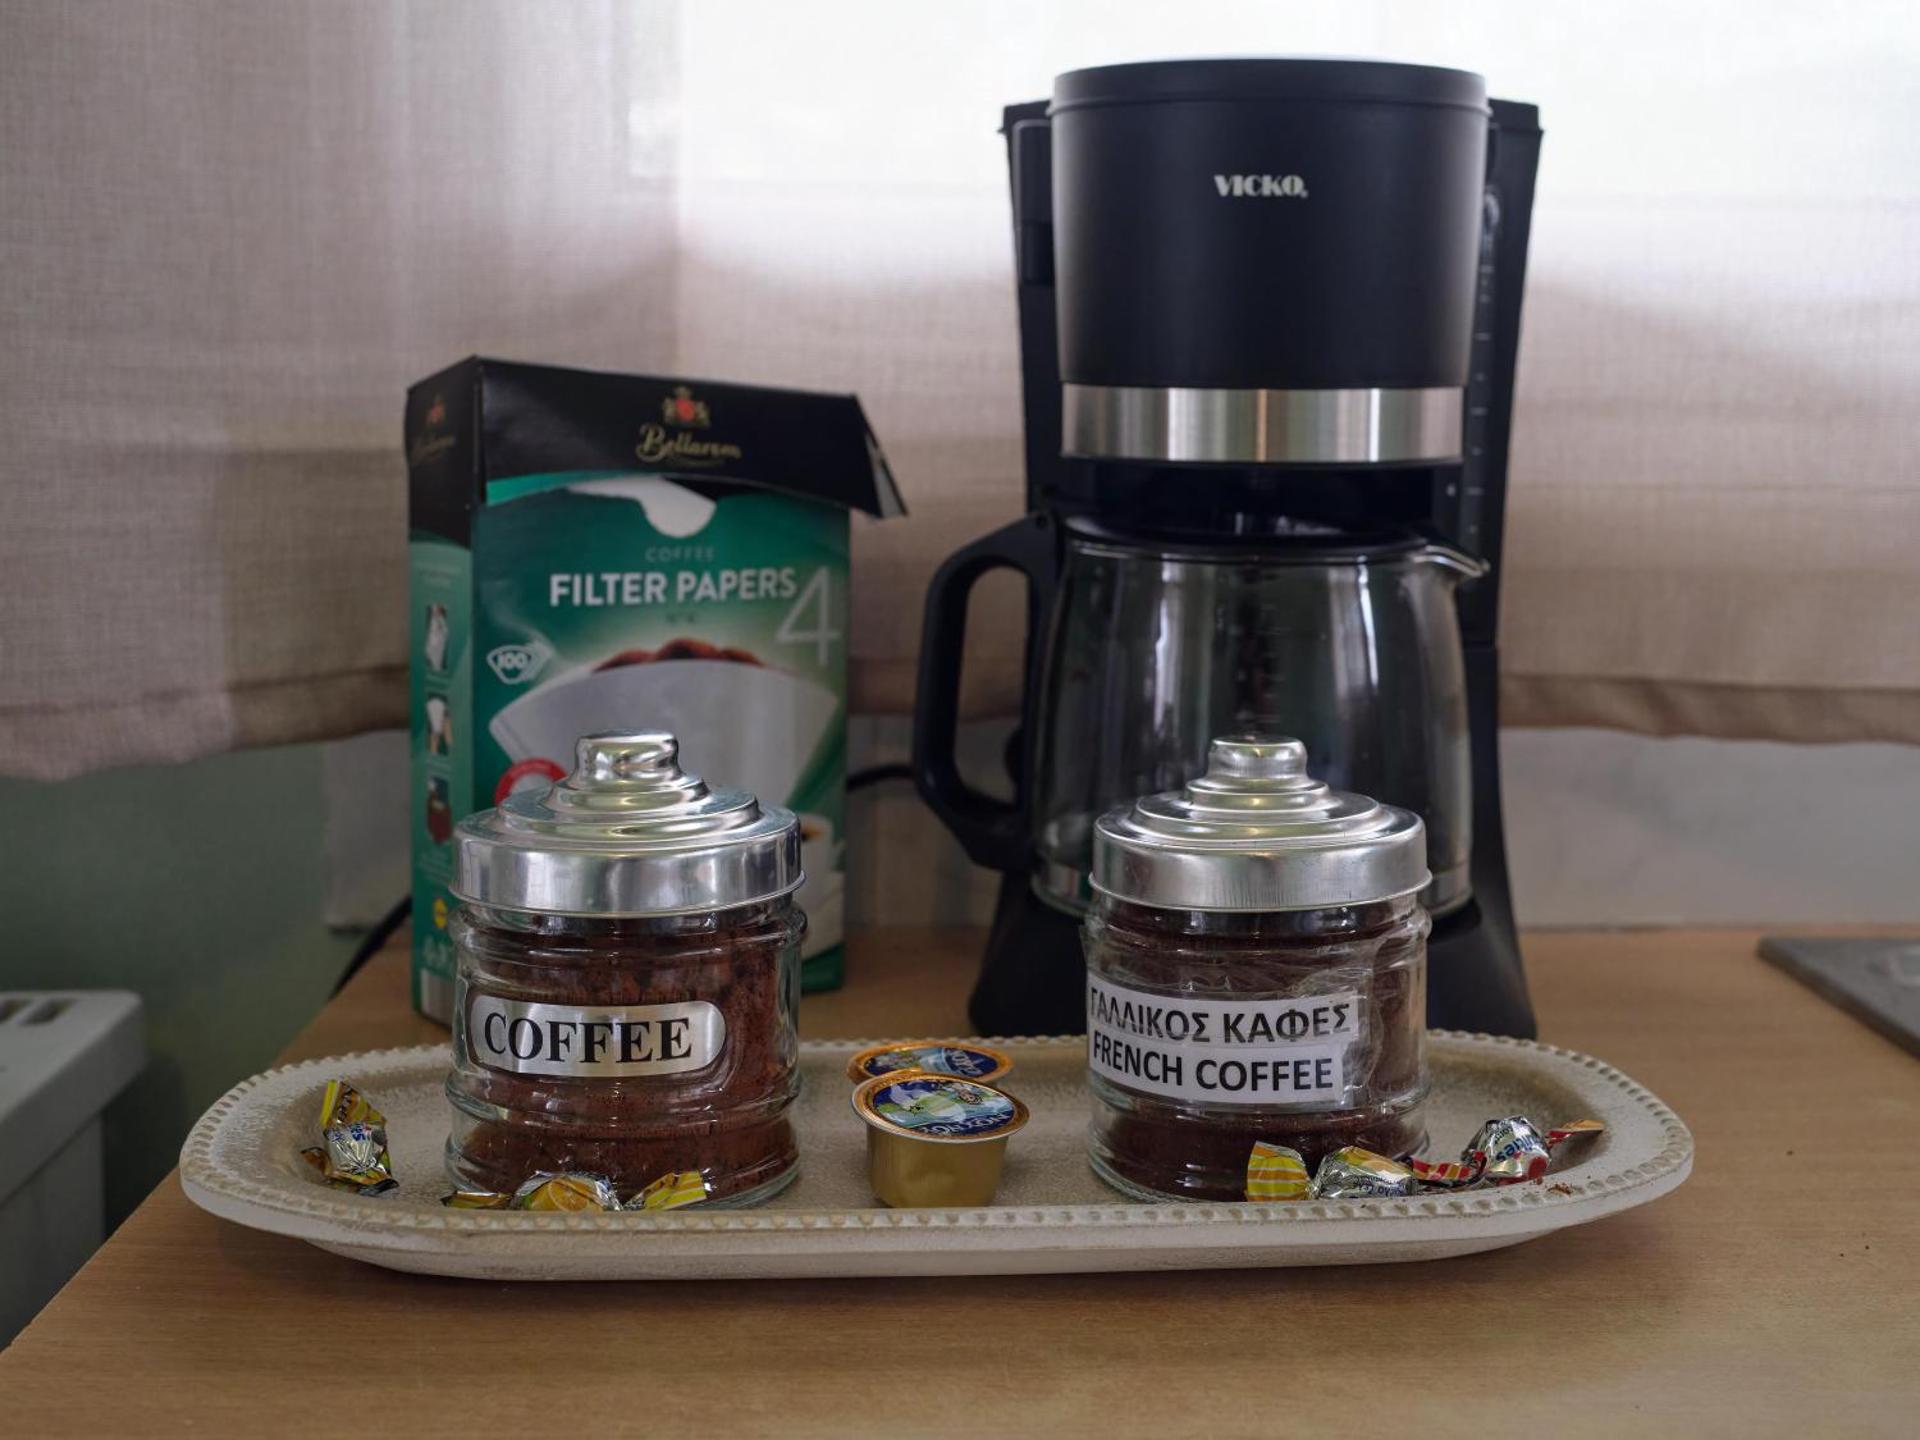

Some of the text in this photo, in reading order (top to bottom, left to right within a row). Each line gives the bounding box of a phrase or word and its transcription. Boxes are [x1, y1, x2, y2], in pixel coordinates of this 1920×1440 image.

[550, 567, 797, 607] FILTER PAPERS
[775, 565, 842, 666] 4
[484, 1011, 692, 1064] COFFEE
[1223, 1003, 1350, 1044] ΚΑΦΕΣ
[1093, 1029, 1333, 1092] FRENCH COFFEE
